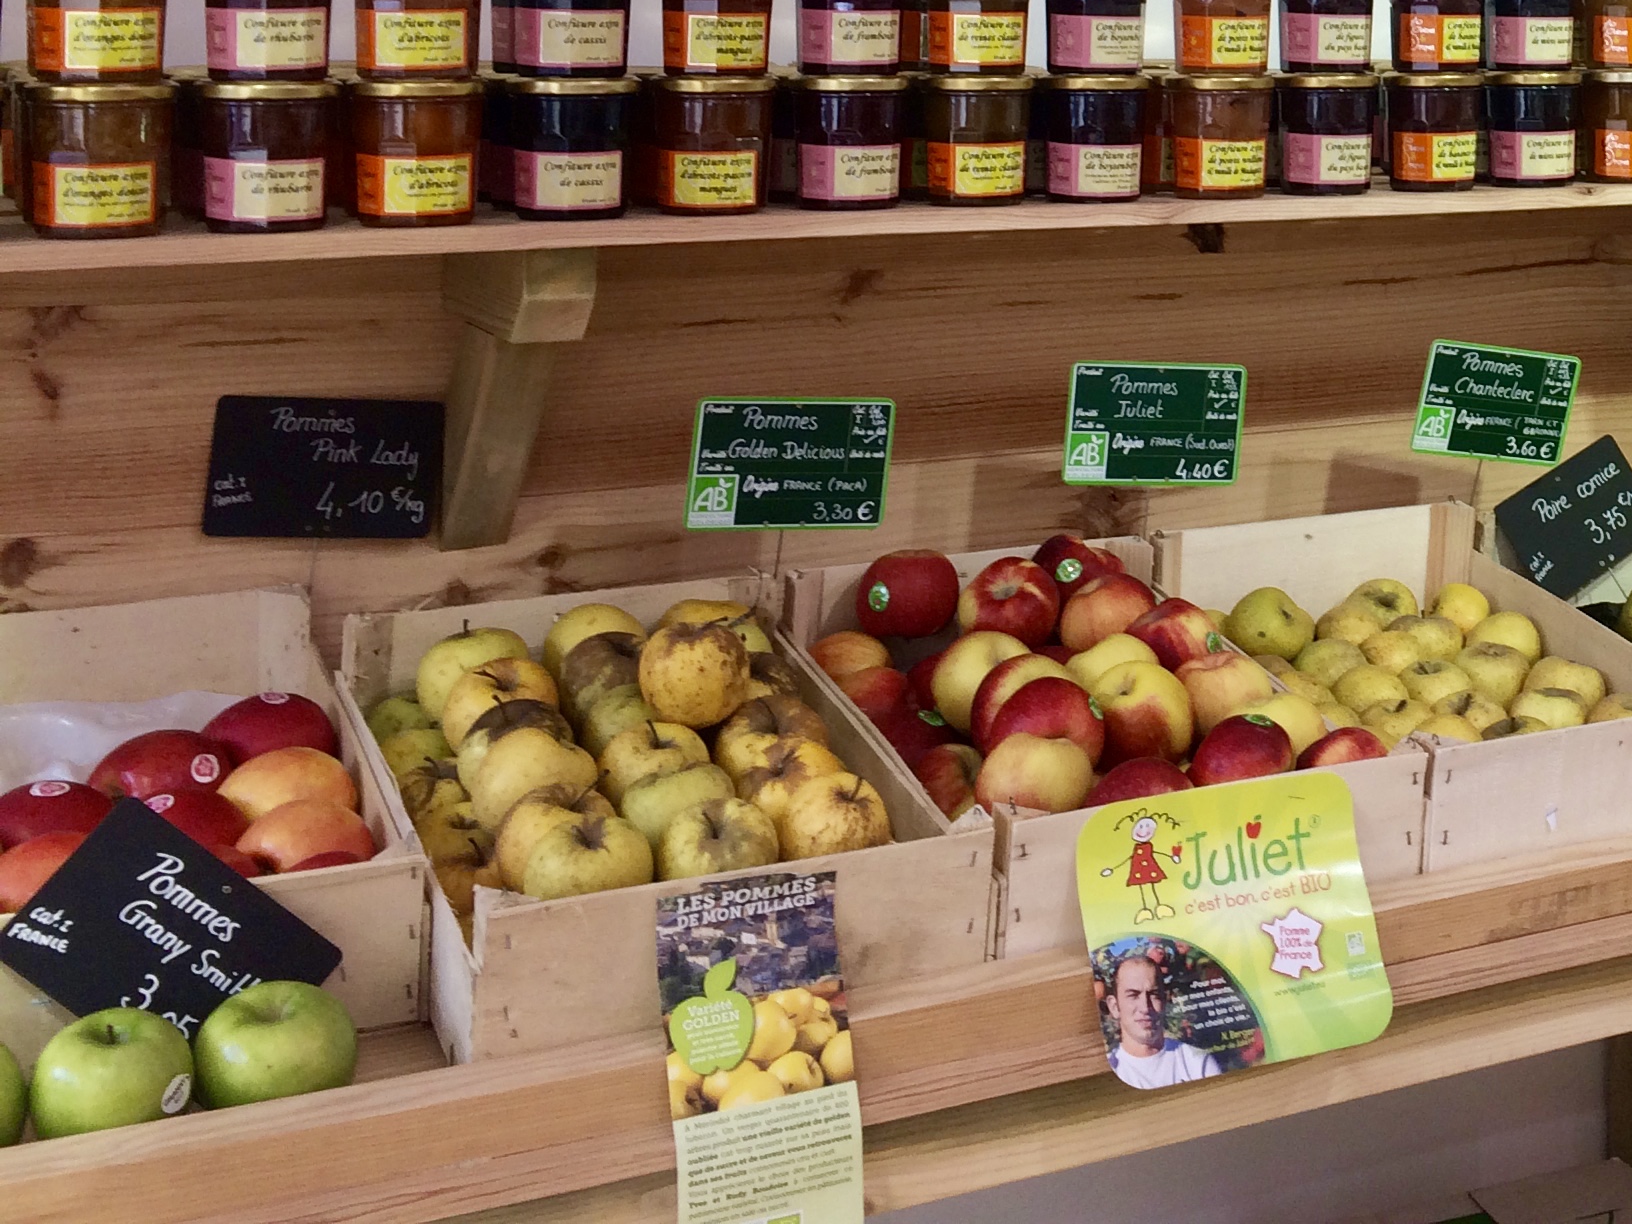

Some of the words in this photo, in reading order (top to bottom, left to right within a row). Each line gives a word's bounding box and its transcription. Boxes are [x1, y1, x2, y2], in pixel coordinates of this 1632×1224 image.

[1462, 351, 1524, 378] Pommes
[1109, 373, 1178, 396] Pommes
[1454, 376, 1535, 403] Chanteclerc
[270, 406, 356, 434] Pommes
[742, 405, 819, 431] Pommes
[1113, 399, 1164, 419] Juliet
[1418, 416, 1445, 437] AB
[309, 437, 362, 463] Pink
[370, 439, 419, 481] Lady
[727, 438, 778, 460] Golden
[781, 441, 846, 460] Delicious
[1069, 443, 1100, 466] AB
[783, 479, 822, 491] FRANCE
[1532, 495, 1572, 522] Poire
[1576, 462, 1621, 498] comice
[693, 486, 729, 512] AB
[1183, 814, 1311, 890] Juliet
[136, 852, 242, 943] Pommes
[677, 892, 716, 915] LES
[721, 876, 816, 906] POMMES
[1184, 894, 1221, 915] c'est
[1260, 882, 1296, 902] c'est
[1300, 873, 1331, 895] BIO
[677, 914, 699, 929] DE
[702, 905, 742, 925] MON
[744, 891, 815, 916] VILLAGE
[6, 922, 70, 954] FRANCE
[1279, 926, 1310, 936] Pomme
[1279, 949, 1312, 960] France
[682, 1009, 739, 1031] GOLDEN
